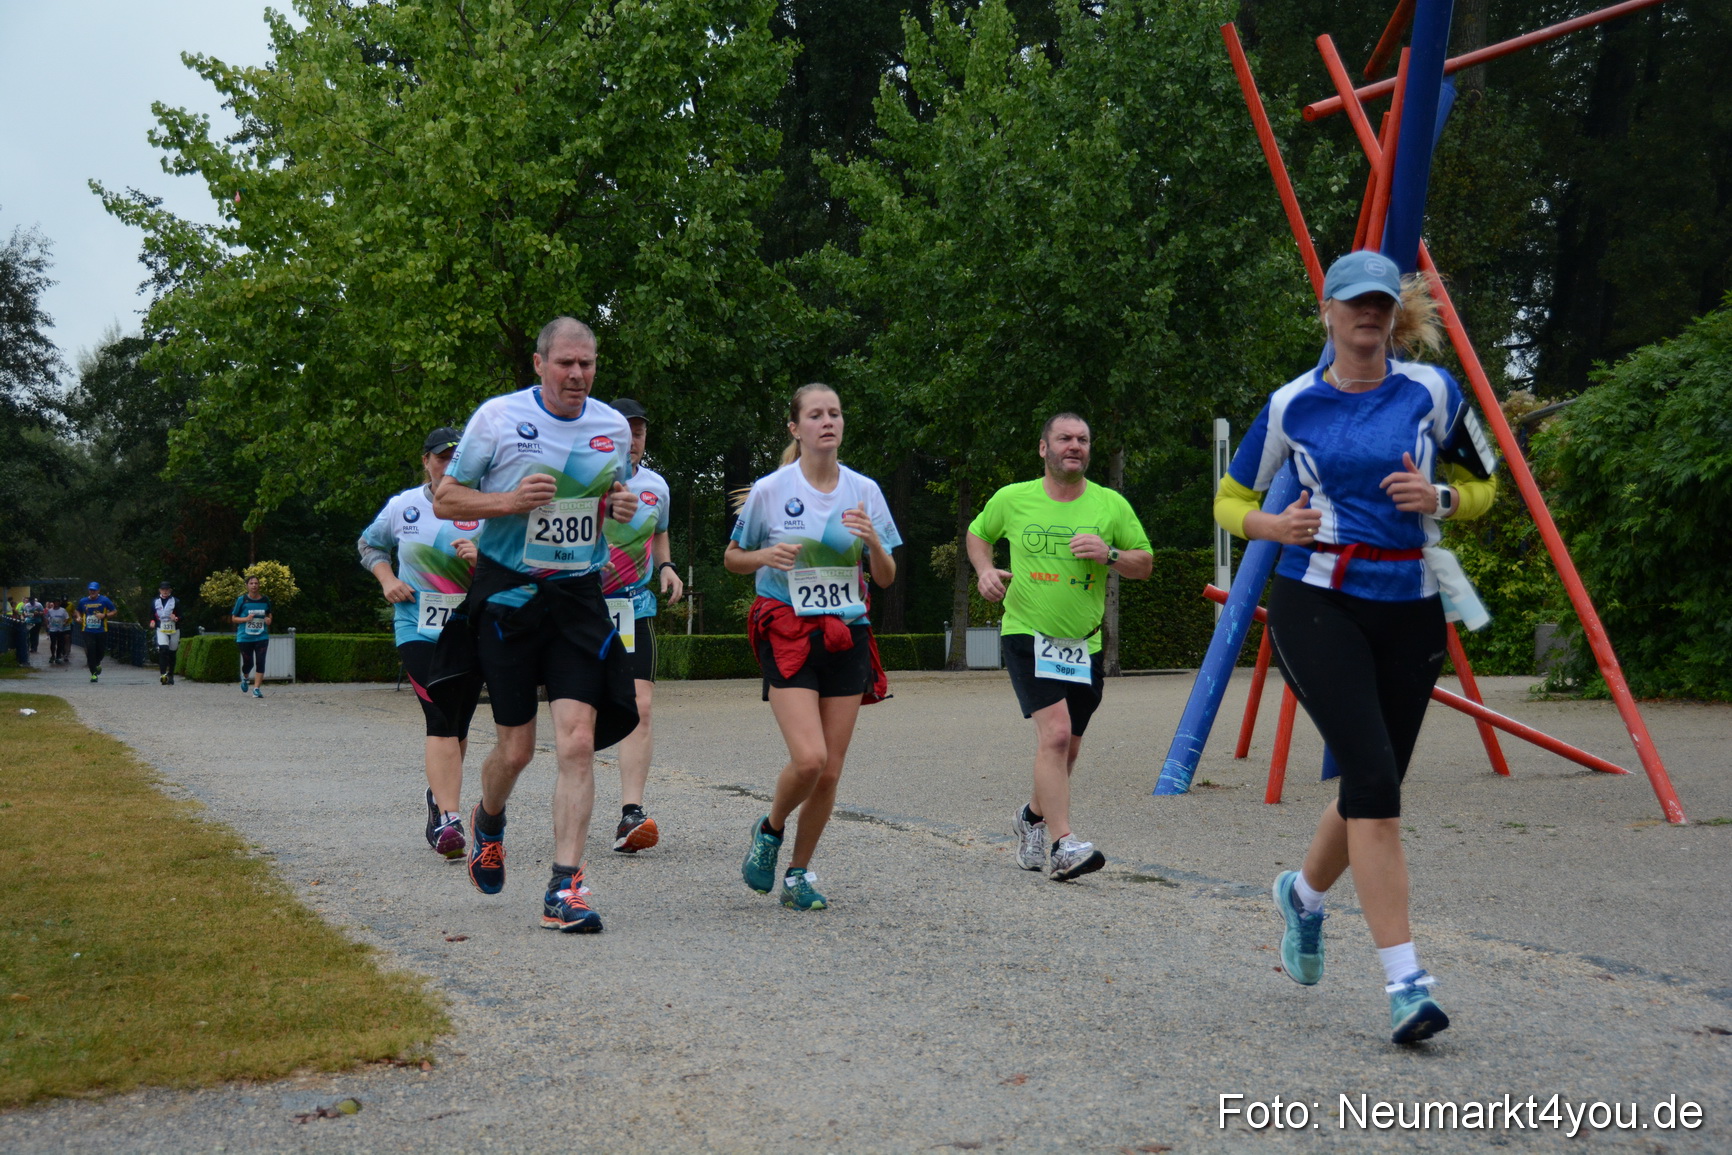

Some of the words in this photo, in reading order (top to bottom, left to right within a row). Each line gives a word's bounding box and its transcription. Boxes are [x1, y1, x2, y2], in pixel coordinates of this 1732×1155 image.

[517, 442, 542, 450] PARTL
[560, 501, 593, 511] BOCK
[535, 515, 593, 544] 2380
[554, 550, 575, 561] Karl
[798, 582, 853, 608] 2381
[607, 600, 629, 608] OCK
[247, 621, 263, 629] 2533
[1055, 664, 1076, 675] Sepp
